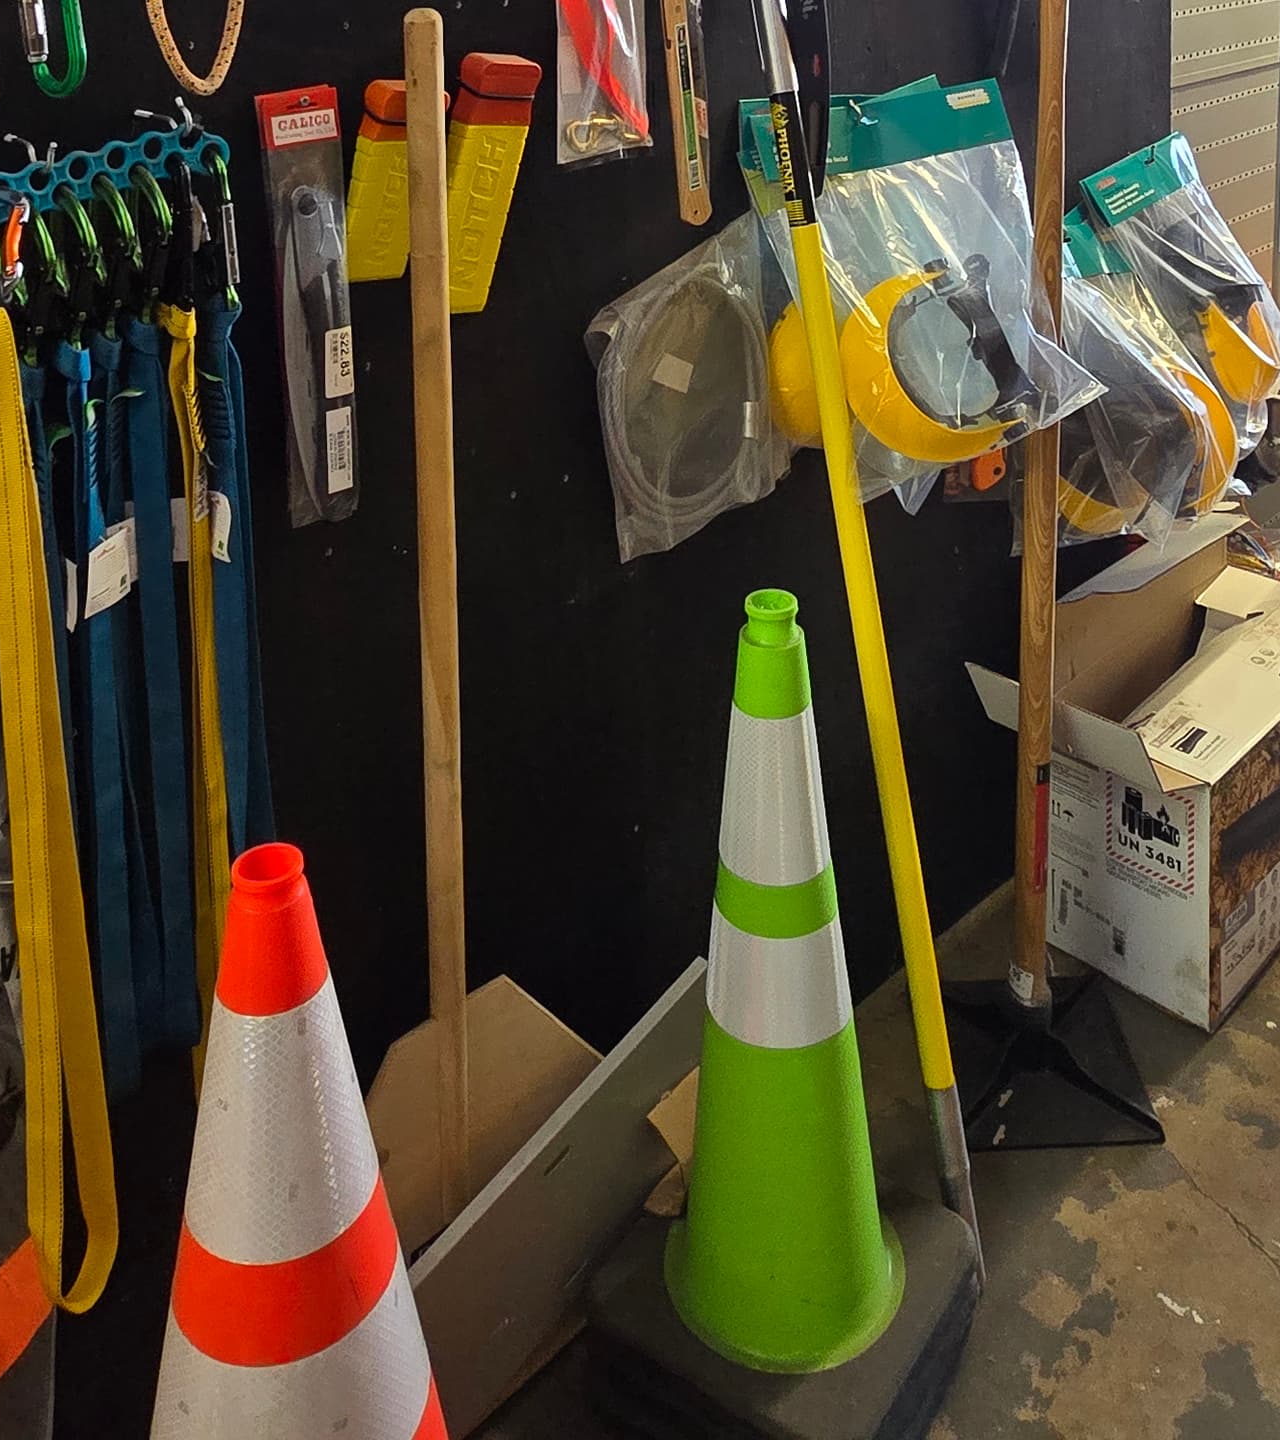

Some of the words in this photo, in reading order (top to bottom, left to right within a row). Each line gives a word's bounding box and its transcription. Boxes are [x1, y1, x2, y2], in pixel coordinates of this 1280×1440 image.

[277, 113, 331, 132] CALICO
[775, 128, 797, 194] PHOENIX
[451, 135, 508, 294] NOTCH
[339, 331, 352, 378] $22.83
[1117, 831, 1140, 854] UN
[1144, 845, 1182, 873] 3481
